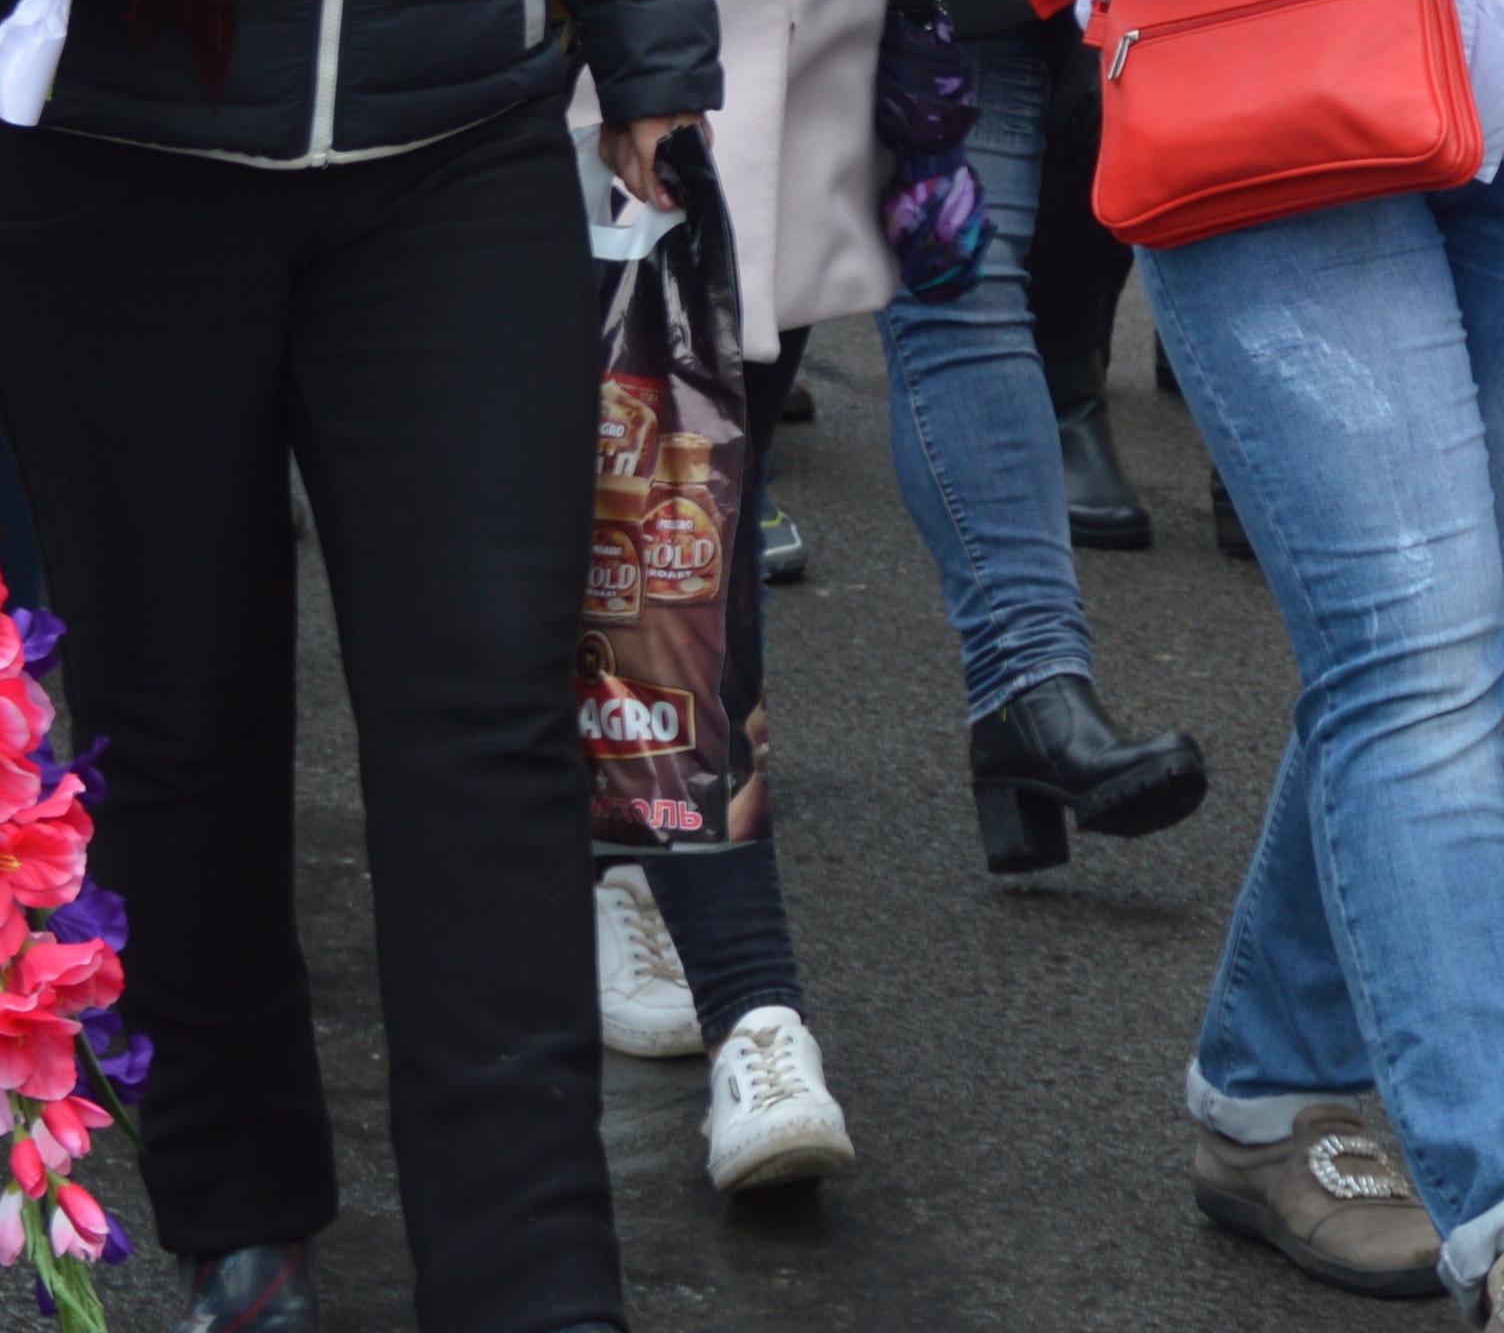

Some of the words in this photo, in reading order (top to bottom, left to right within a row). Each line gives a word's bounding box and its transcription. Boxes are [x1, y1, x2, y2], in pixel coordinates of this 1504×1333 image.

[600, 422, 625, 438] GRO
[588, 564, 637, 590] OLD
[578, 697, 679, 743] AGRO
